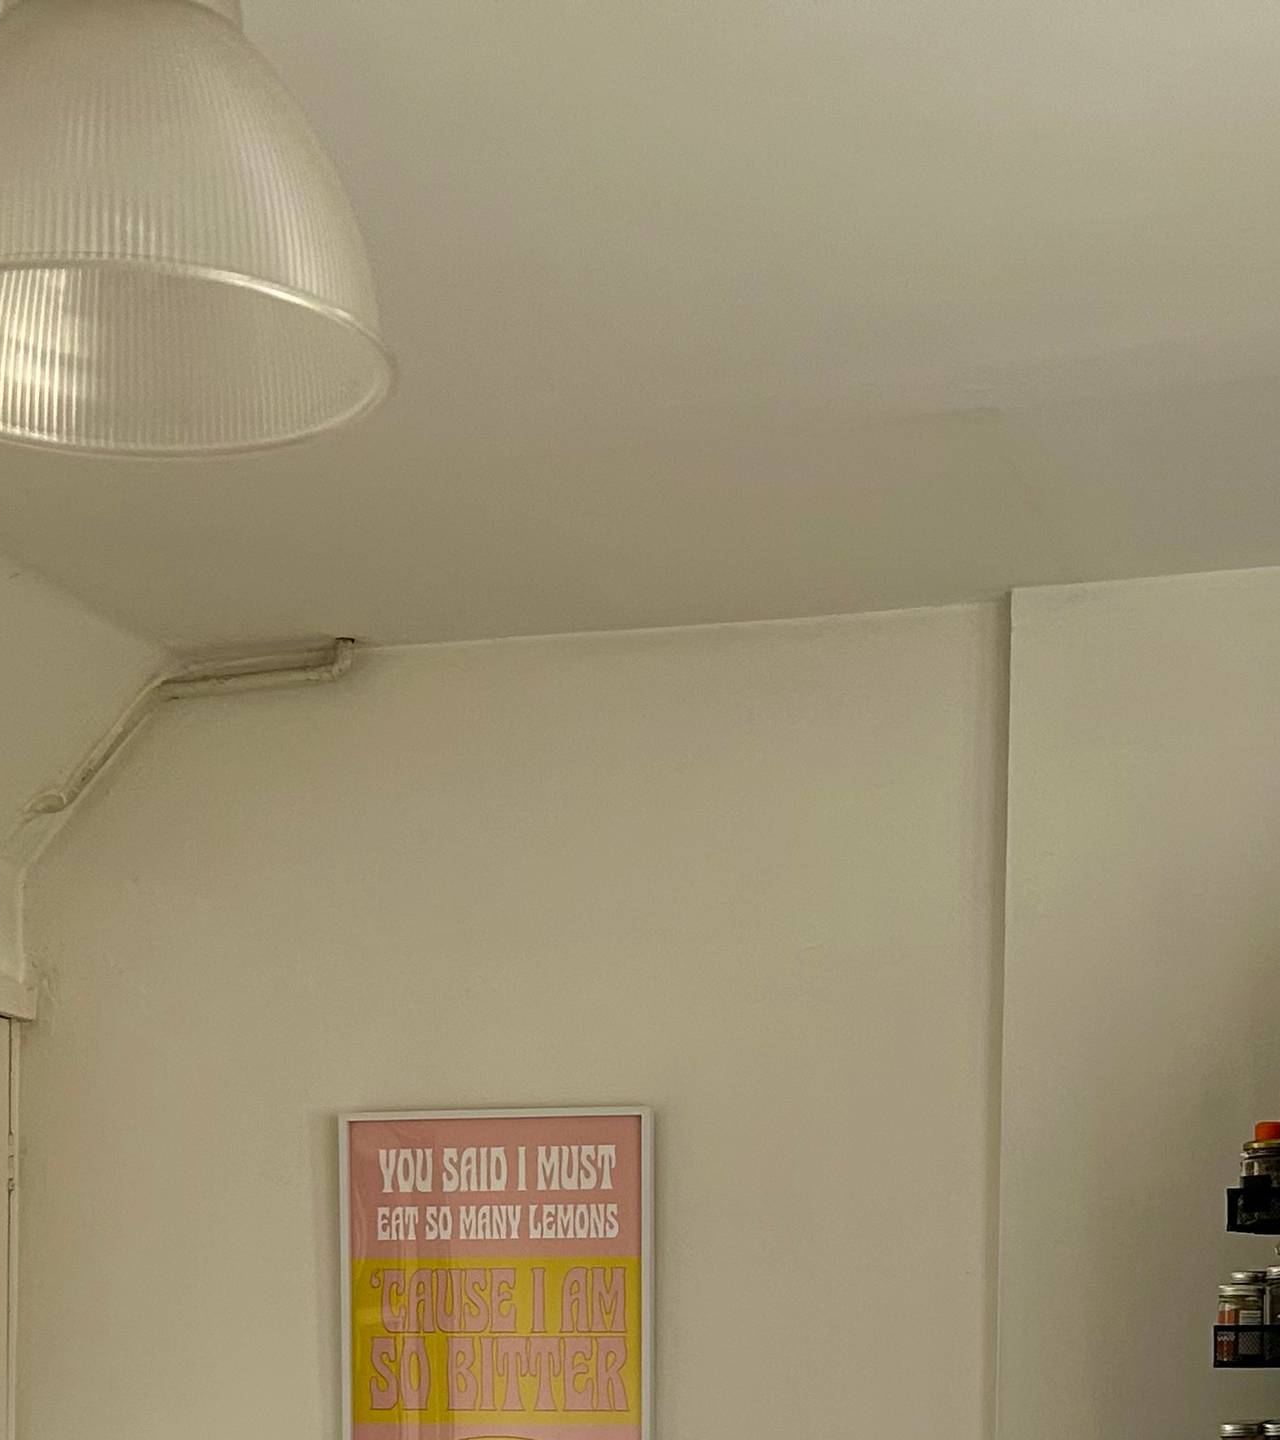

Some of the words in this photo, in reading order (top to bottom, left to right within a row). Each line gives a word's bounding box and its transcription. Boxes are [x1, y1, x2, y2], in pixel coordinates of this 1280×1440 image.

[379, 1147, 433, 1193] YOU
[442, 1145, 508, 1193] SAID
[518, 1145, 527, 1192] I
[536, 1144, 616, 1191] MUST
[377, 1206, 419, 1241] EAT
[425, 1206, 453, 1240] SO
[459, 1205, 522, 1240] MANY
[528, 1204, 619, 1239] LEMONS
[530, 1266, 548, 1333] I
[559, 1266, 626, 1333] AM
[369, 1336, 431, 1411] SO
[447, 1336, 630, 1412] BITTER
